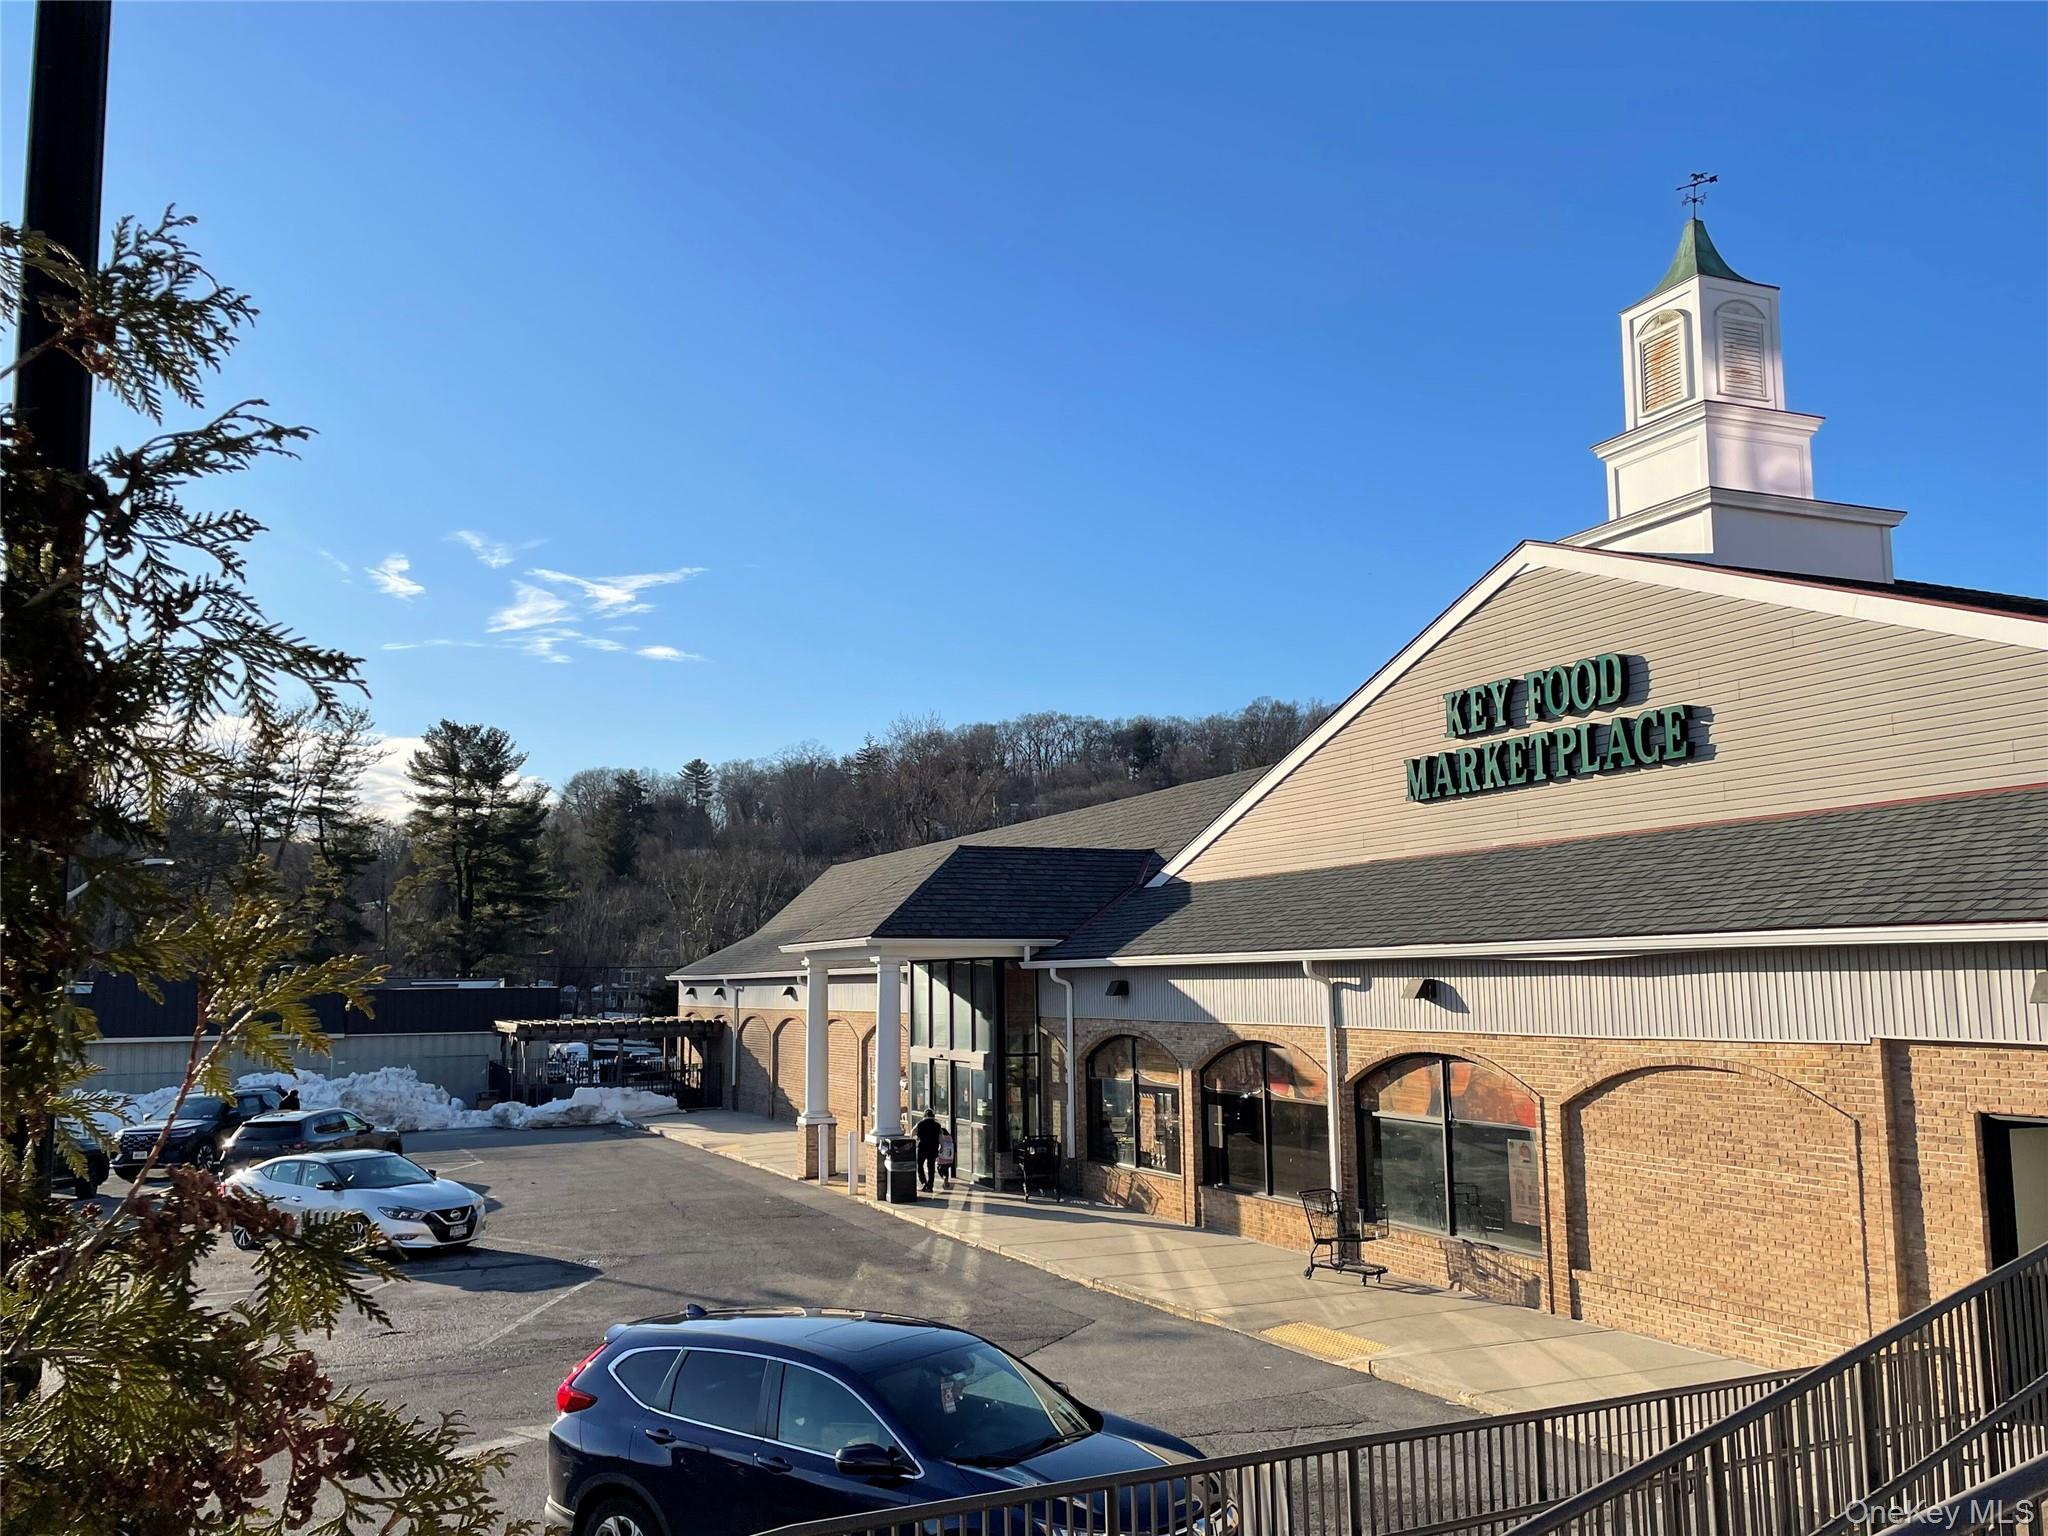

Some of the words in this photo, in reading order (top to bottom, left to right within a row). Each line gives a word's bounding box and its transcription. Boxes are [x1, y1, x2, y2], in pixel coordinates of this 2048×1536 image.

[1443, 678, 1513, 738] KEY
[1524, 653, 1626, 721] FOOD
[1404, 705, 1691, 801] MARKETPLACE
